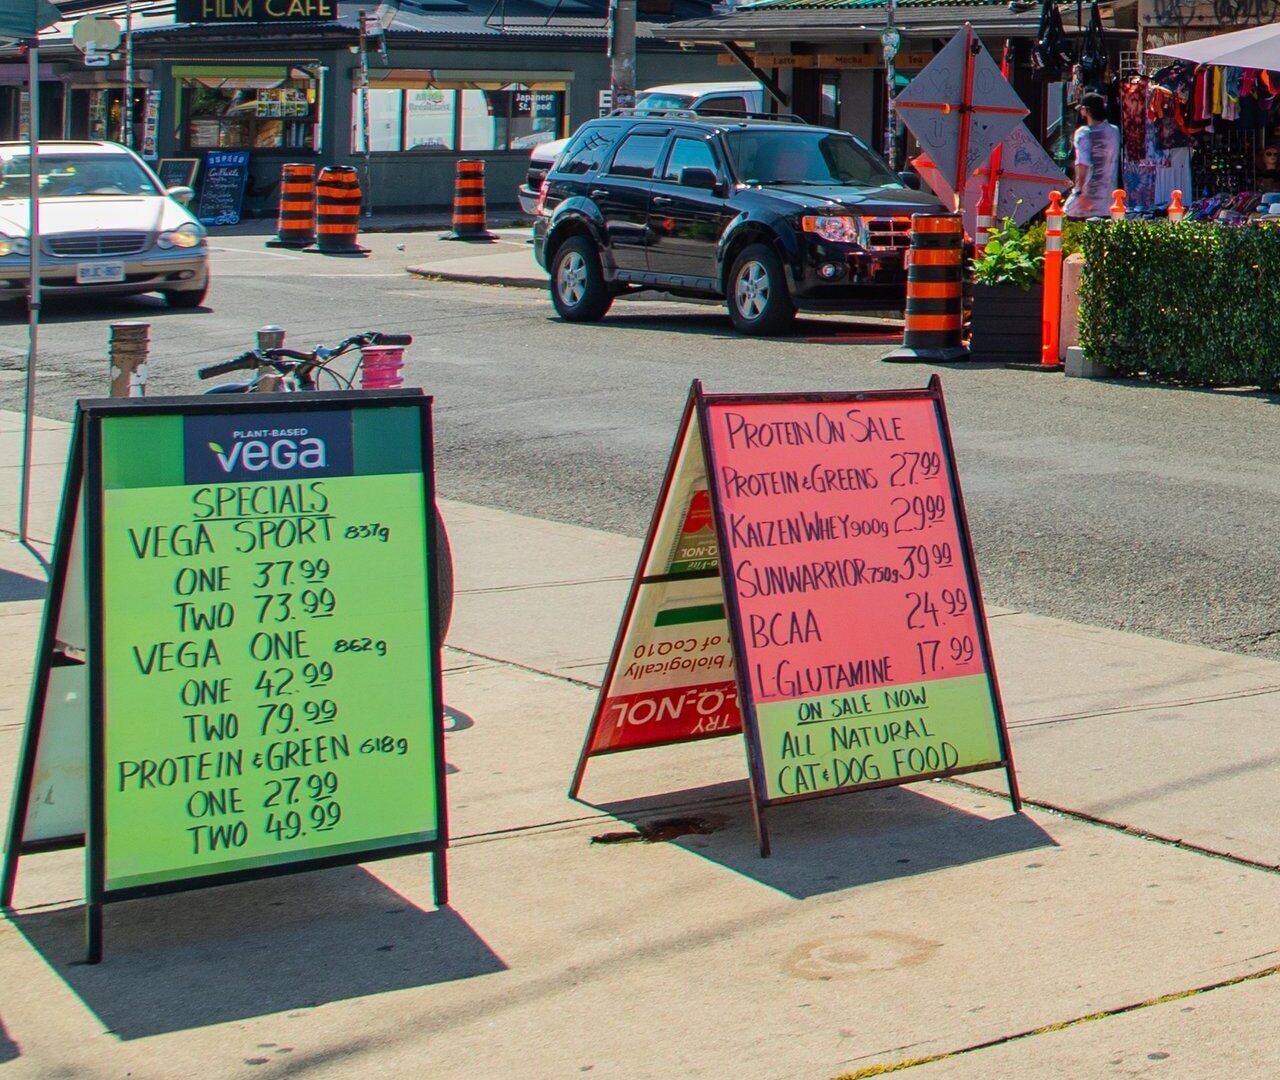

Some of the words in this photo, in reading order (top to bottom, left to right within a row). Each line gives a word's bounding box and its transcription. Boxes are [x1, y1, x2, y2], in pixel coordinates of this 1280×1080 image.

[773, 56, 796, 65] Latte
[835, 56, 862, 64] Mocha
[908, 56, 923, 64] Tea
[516, 92, 556, 102] Japanese
[233, 427, 309, 439] PLANT-BASED
[726, 412, 811, 449] PROTEIN
[853, 409, 906, 444] SALE
[193, 481, 331, 521] SPECIALS
[722, 465, 799, 500] PROTEIN
[128, 522, 216, 561] VEGA
[235, 516, 336, 554] SPORT
[344, 522, 391, 543] 837g
[732, 514, 800, 550] KAIZEN
[800, 510, 849, 543] WHEY
[850, 520, 889, 540] 900g
[175, 566, 231, 597] ONE
[253, 557, 331, 589] 37.99
[736, 559, 869, 599] SUNWARRIOR
[867, 565, 899, 586] 750g
[174, 602, 236, 633] TWO
[257, 587, 337, 623] 73.99
[749, 610, 822, 650] BCAA
[905, 588, 969, 631] 24.99
[133, 639, 222, 675] VEGA
[249, 629, 311, 662] ONE
[334, 637, 388, 657] 862g
[633, 638, 698, 659] CoQ10
[700, 635, 722, 652] of
[917, 634, 974, 677] 17.99
[180, 677, 233, 708] ONE
[254, 660, 335, 698] 42.99
[623, 654, 726, 680] biologically
[183, 712, 240, 744] TWO
[257, 698, 338, 737] 79.99
[690, 714, 732, 735] TRY
[797, 700, 823, 725] ON
[832, 696, 873, 719] SALE
[885, 686, 928, 710] NOW
[781, 731, 816, 761] ALL
[831, 717, 936, 751] NATURAL
[118, 750, 244, 793] PROTEIN
[359, 736, 409, 756] 618g
[894, 742, 960, 777] FOOD
[186, 787, 244, 819] ONE
[263, 771, 339, 808] 27.99
[187, 820, 248, 855] TWO
[264, 801, 342, 841] 49.99
